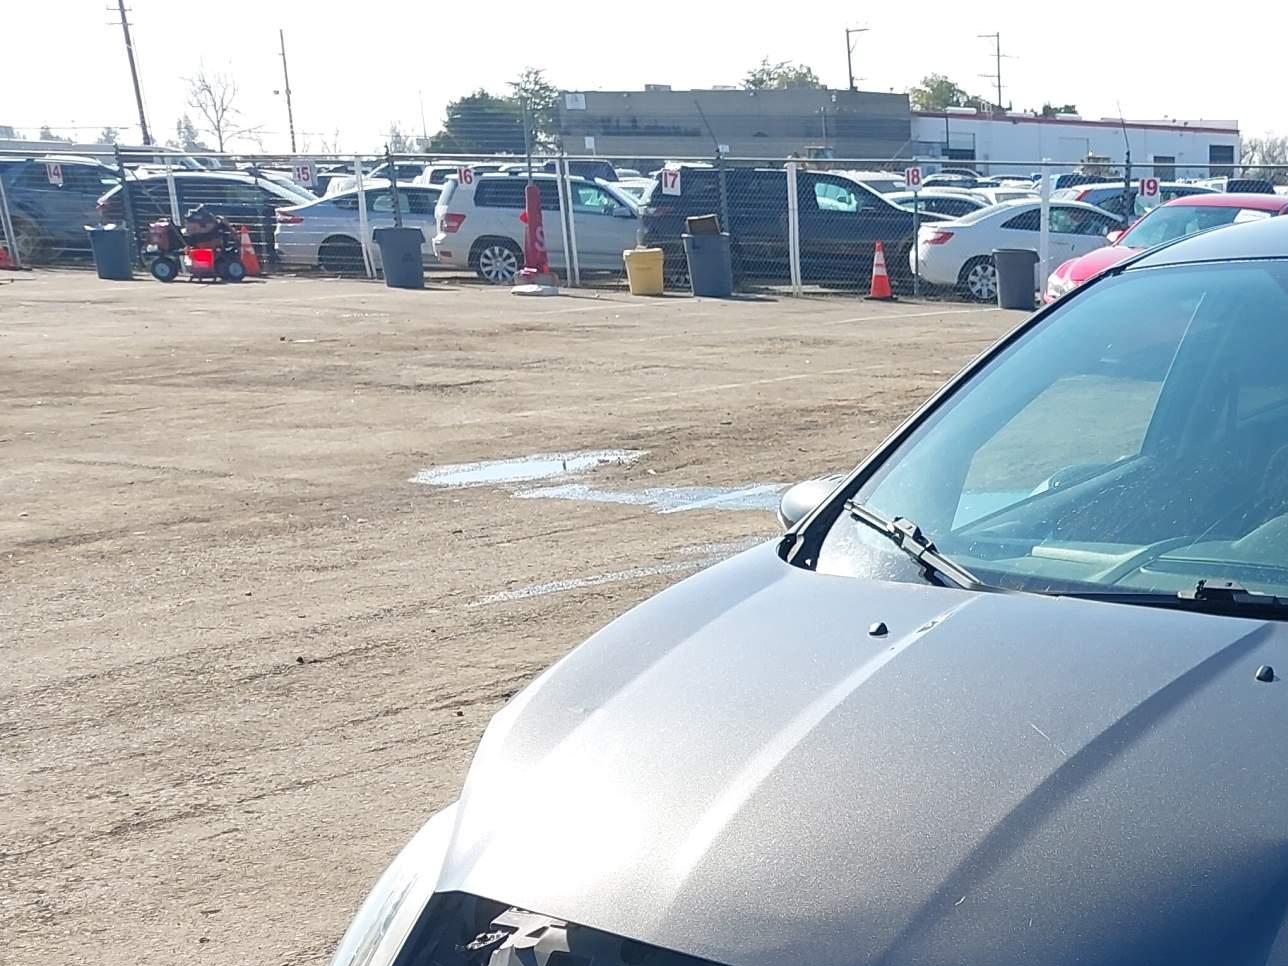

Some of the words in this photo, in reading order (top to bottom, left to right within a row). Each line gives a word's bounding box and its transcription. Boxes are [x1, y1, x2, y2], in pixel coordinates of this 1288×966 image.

[47, 164, 61, 179] 14
[296, 166, 311, 182] 15
[458, 169, 473, 185] 16
[906, 168, 921, 186] 18
[663, 172, 678, 189] 17
[1140, 179, 1158, 197] 19
